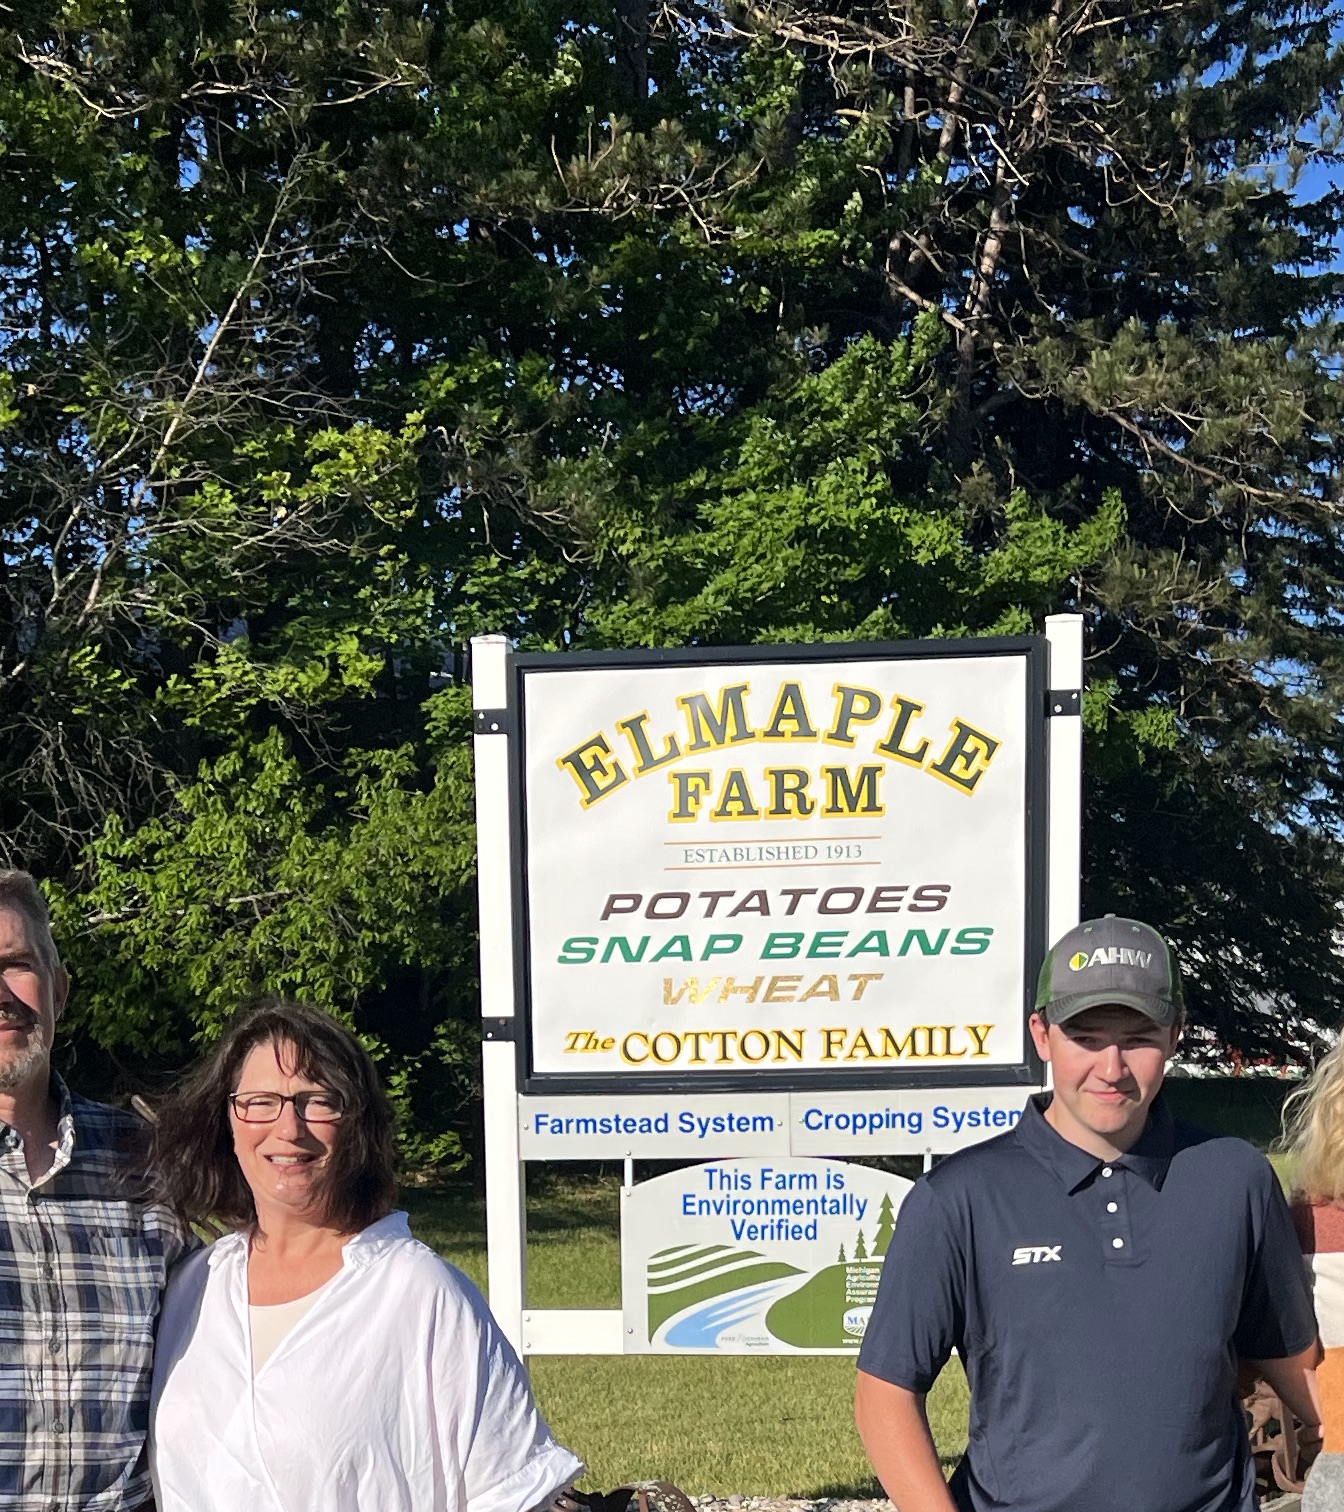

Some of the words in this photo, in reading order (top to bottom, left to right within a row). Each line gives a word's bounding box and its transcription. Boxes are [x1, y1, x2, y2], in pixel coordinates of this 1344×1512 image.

[556, 680, 1003, 811] ELMAPLE
[668, 762, 886, 823] FARM
[683, 844, 818, 864] ESTABLISHED
[826, 843, 862, 860] 1913
[599, 884, 952, 921] POTATOES
[557, 934, 743, 964] SNAP
[759, 927, 994, 960] BEANS
[1088, 946, 1152, 969] AHW
[663, 972, 885, 1005] WHEAT
[564, 1029, 616, 1054] The
[619, 1026, 807, 1066] COTTON
[819, 1023, 996, 1062] FAMILY
[534, 1112, 669, 1135] Farmstead
[678, 1111, 774, 1139] System
[804, 1107, 923, 1135] Cropping
[704, 1168, 752, 1191] This
[761, 1168, 818, 1191] Farm
[826, 1168, 845, 1191] is
[682, 1194, 868, 1221] Environmentally
[730, 1218, 818, 1241] Verified
[1011, 1245, 1062, 1265] STX
